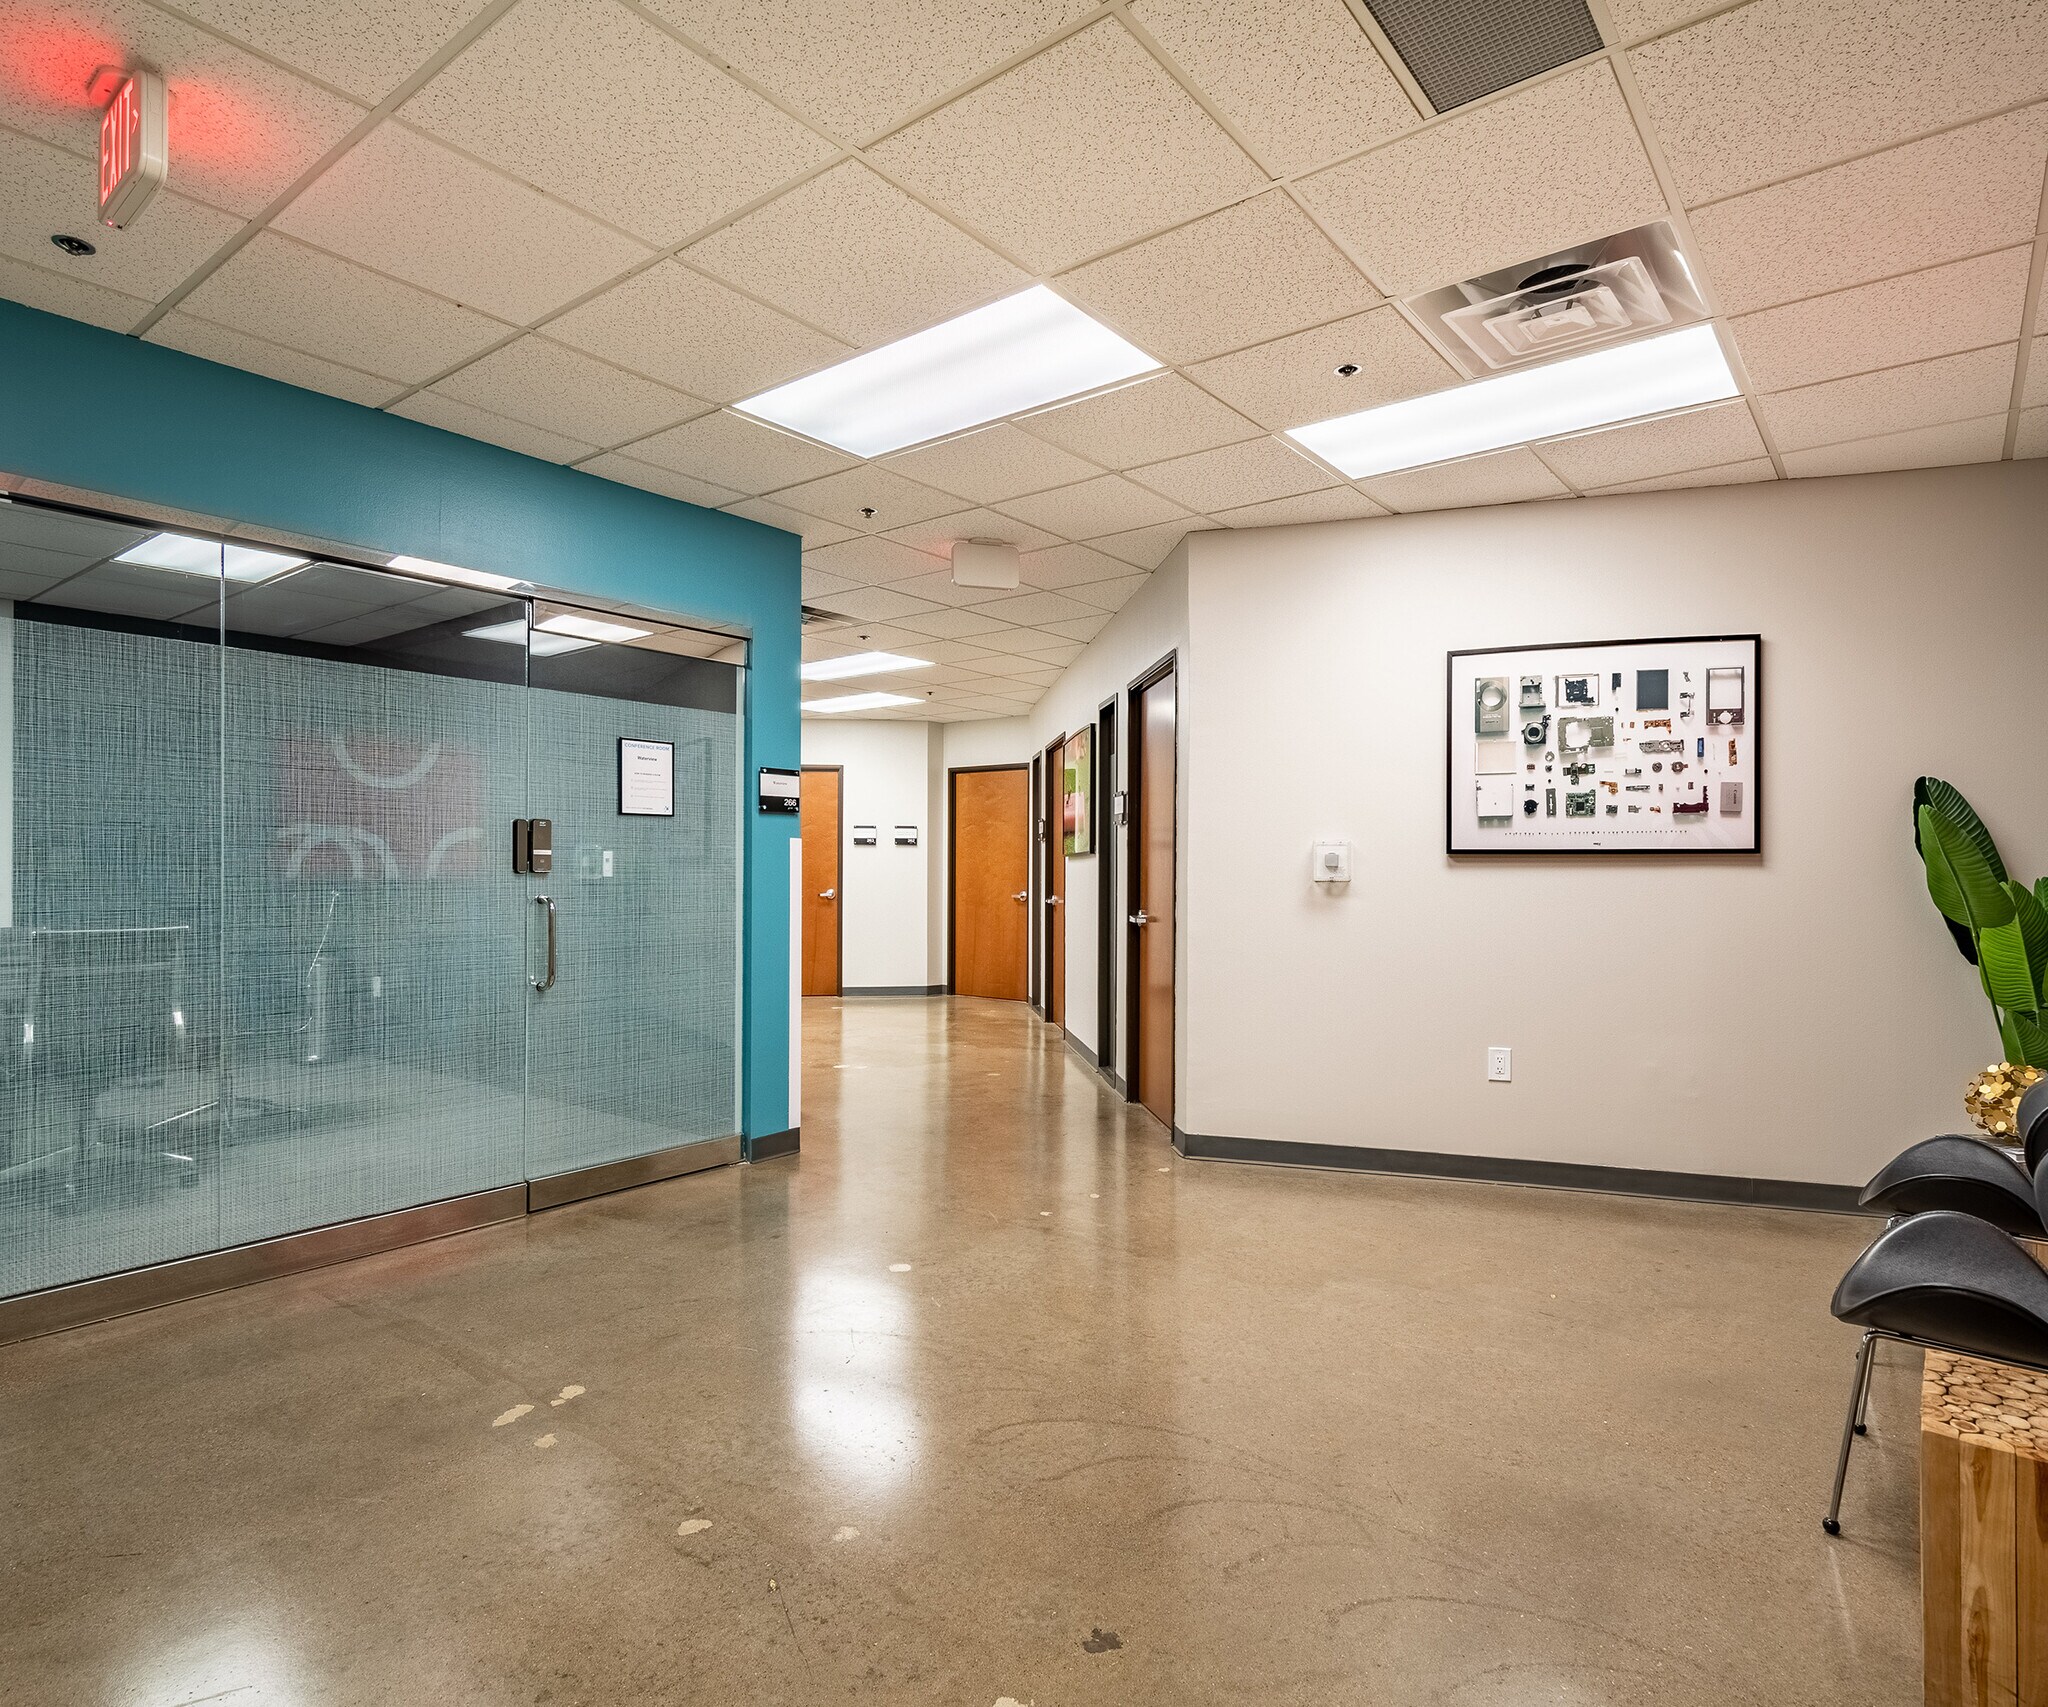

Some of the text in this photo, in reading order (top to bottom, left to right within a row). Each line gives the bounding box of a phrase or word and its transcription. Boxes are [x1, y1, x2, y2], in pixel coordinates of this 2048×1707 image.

[101, 78, 134, 207] EXIT
[624, 742, 655, 751] CONFERENCE
[783, 798, 797, 807] 266
